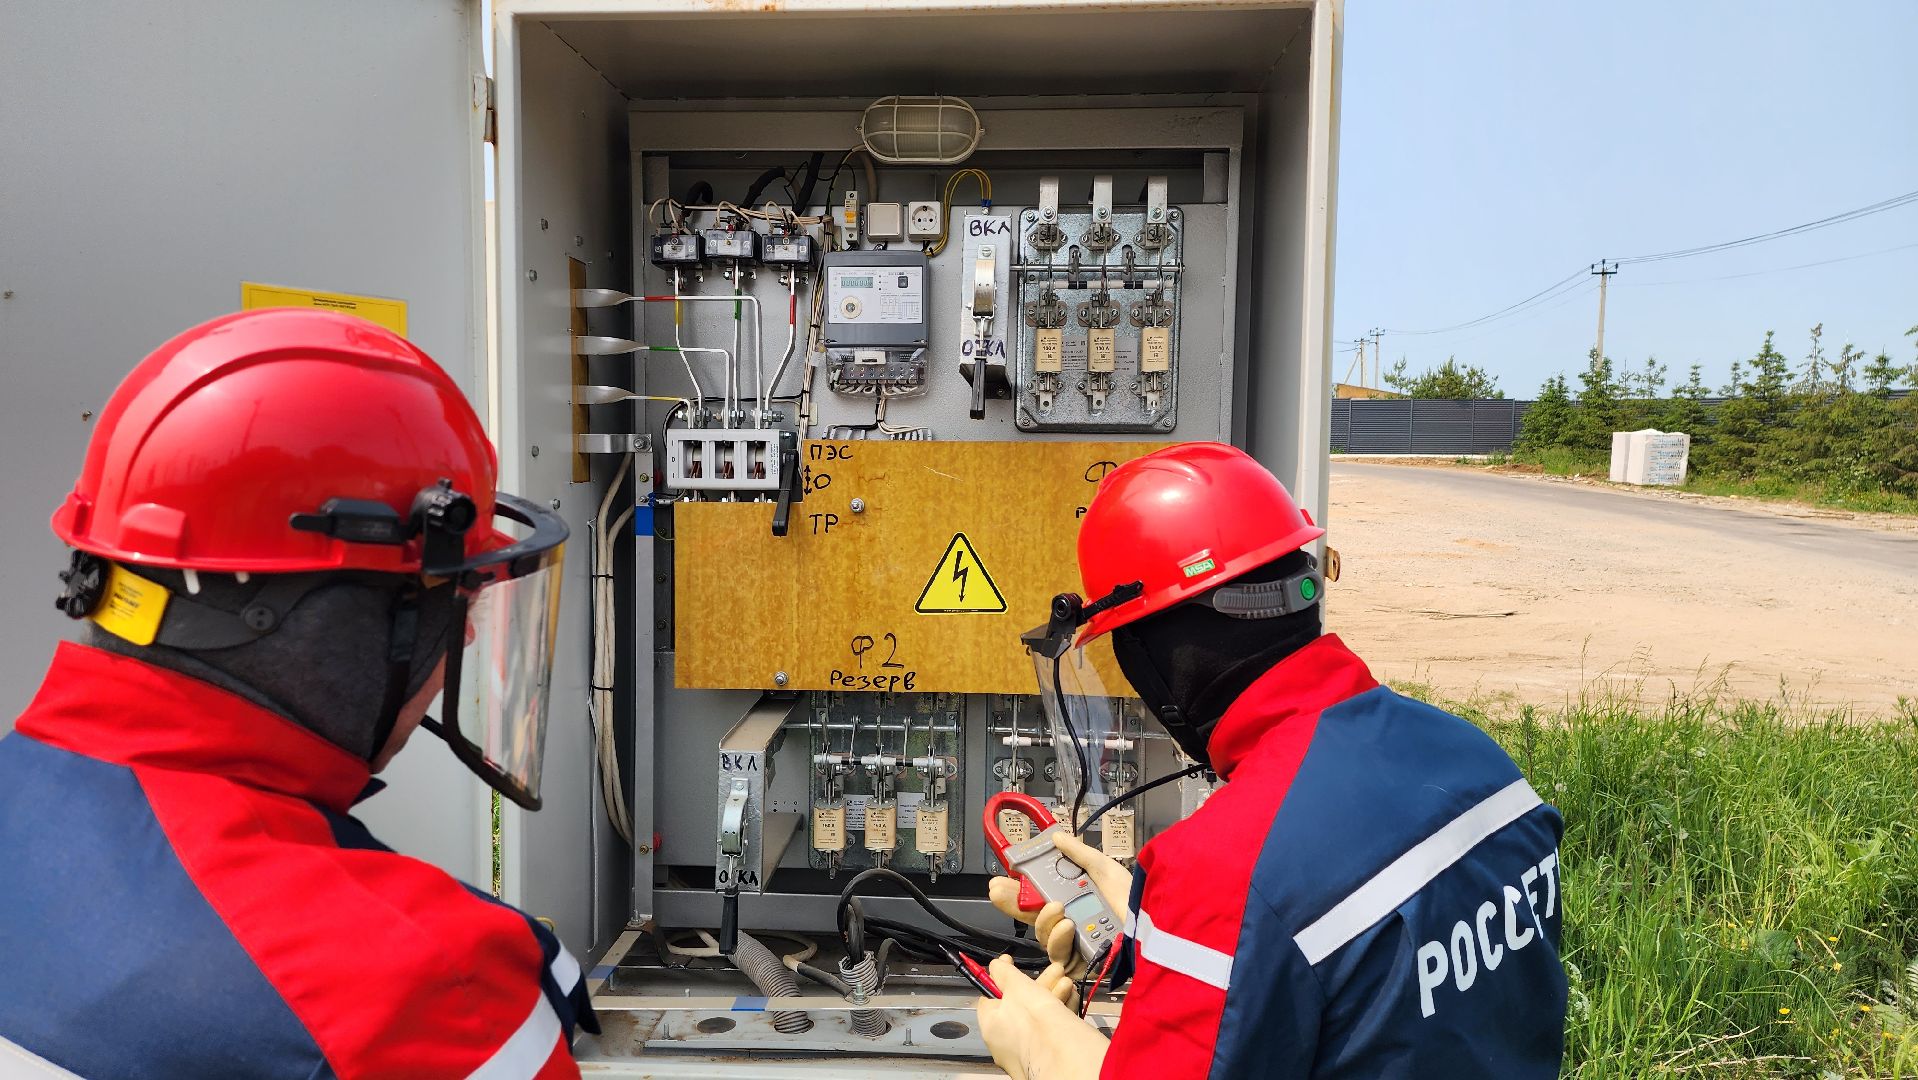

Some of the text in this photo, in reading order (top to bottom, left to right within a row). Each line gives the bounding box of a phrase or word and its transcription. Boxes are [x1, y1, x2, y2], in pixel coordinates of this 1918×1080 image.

[969, 219, 1011, 236] ВКЛ
[810, 444, 853, 460] ПЭС
[809, 513, 839, 535] ТР
[1185, 560, 1214, 576] MSA
[830, 669, 916, 692] Резерв
[721, 752, 758, 771] ВКЛ
[719, 869, 759, 886] ОКЛ
[1418, 846, 1561, 1019] РОССЕТ
